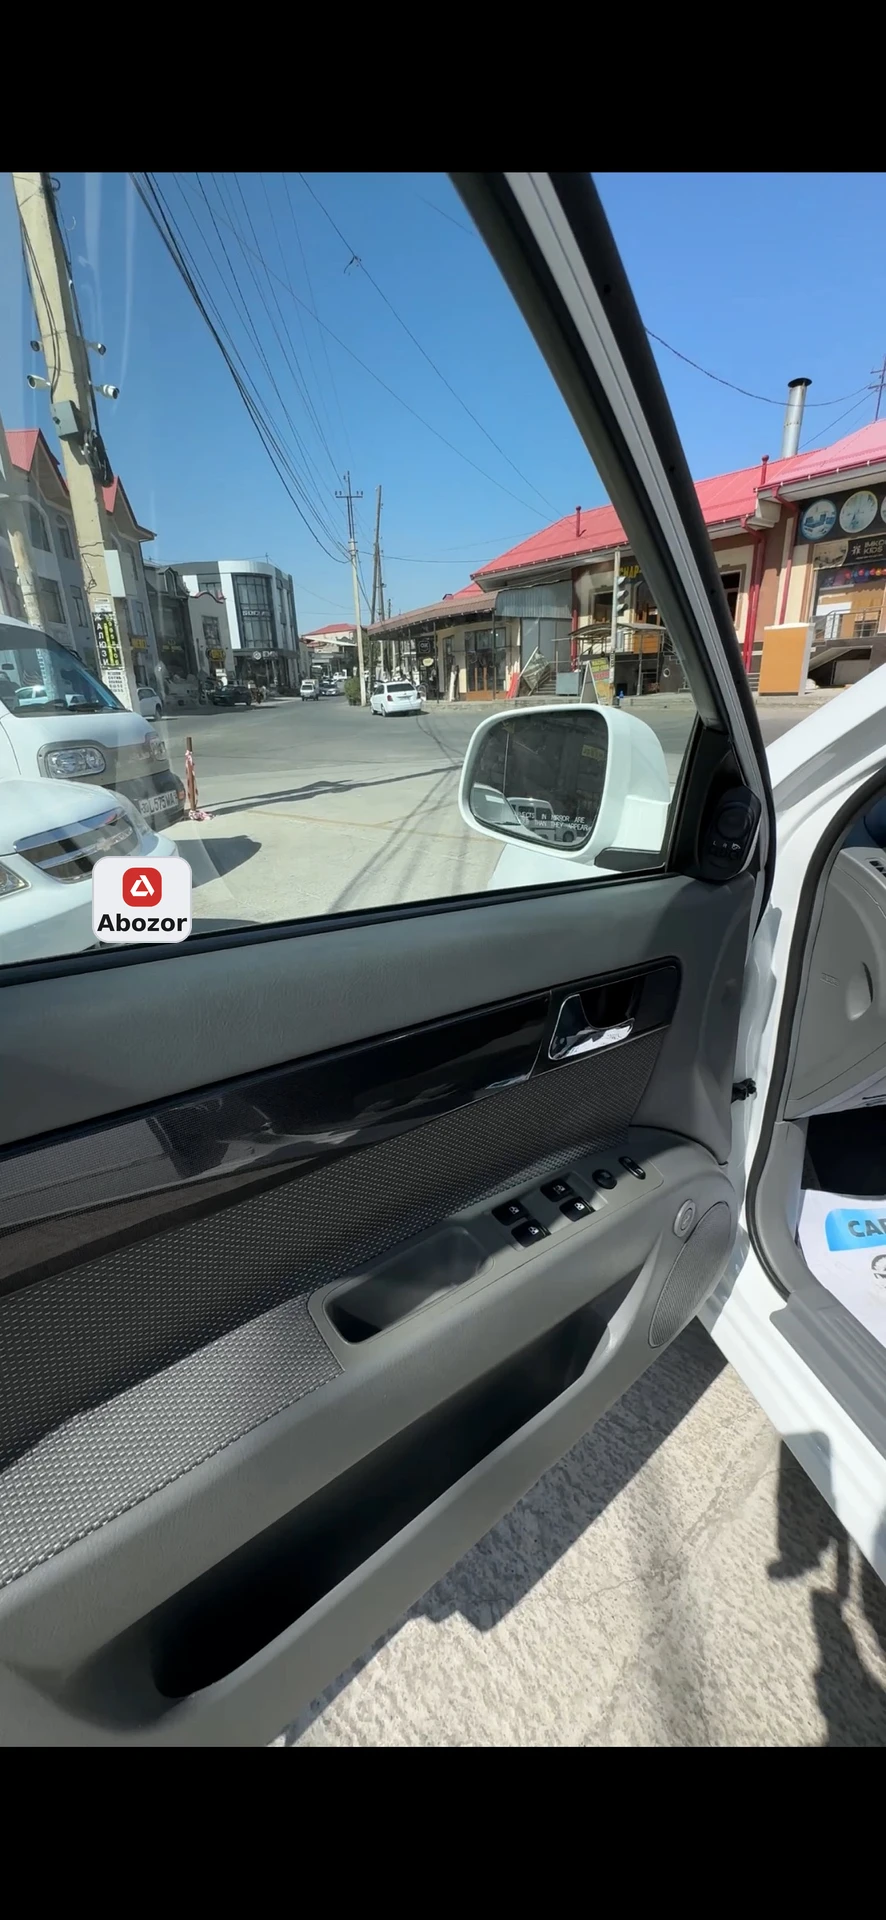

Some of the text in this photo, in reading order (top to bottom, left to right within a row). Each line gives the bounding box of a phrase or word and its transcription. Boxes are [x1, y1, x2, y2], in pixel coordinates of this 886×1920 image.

[94, 613, 109, 666] ЖАЛЮЗИ
[551, 814, 570, 822] MIRROR
[574, 816, 586, 824] ARE
[551, 820, 563, 828] THEY
[568, 822, 589, 831] APPEAR
